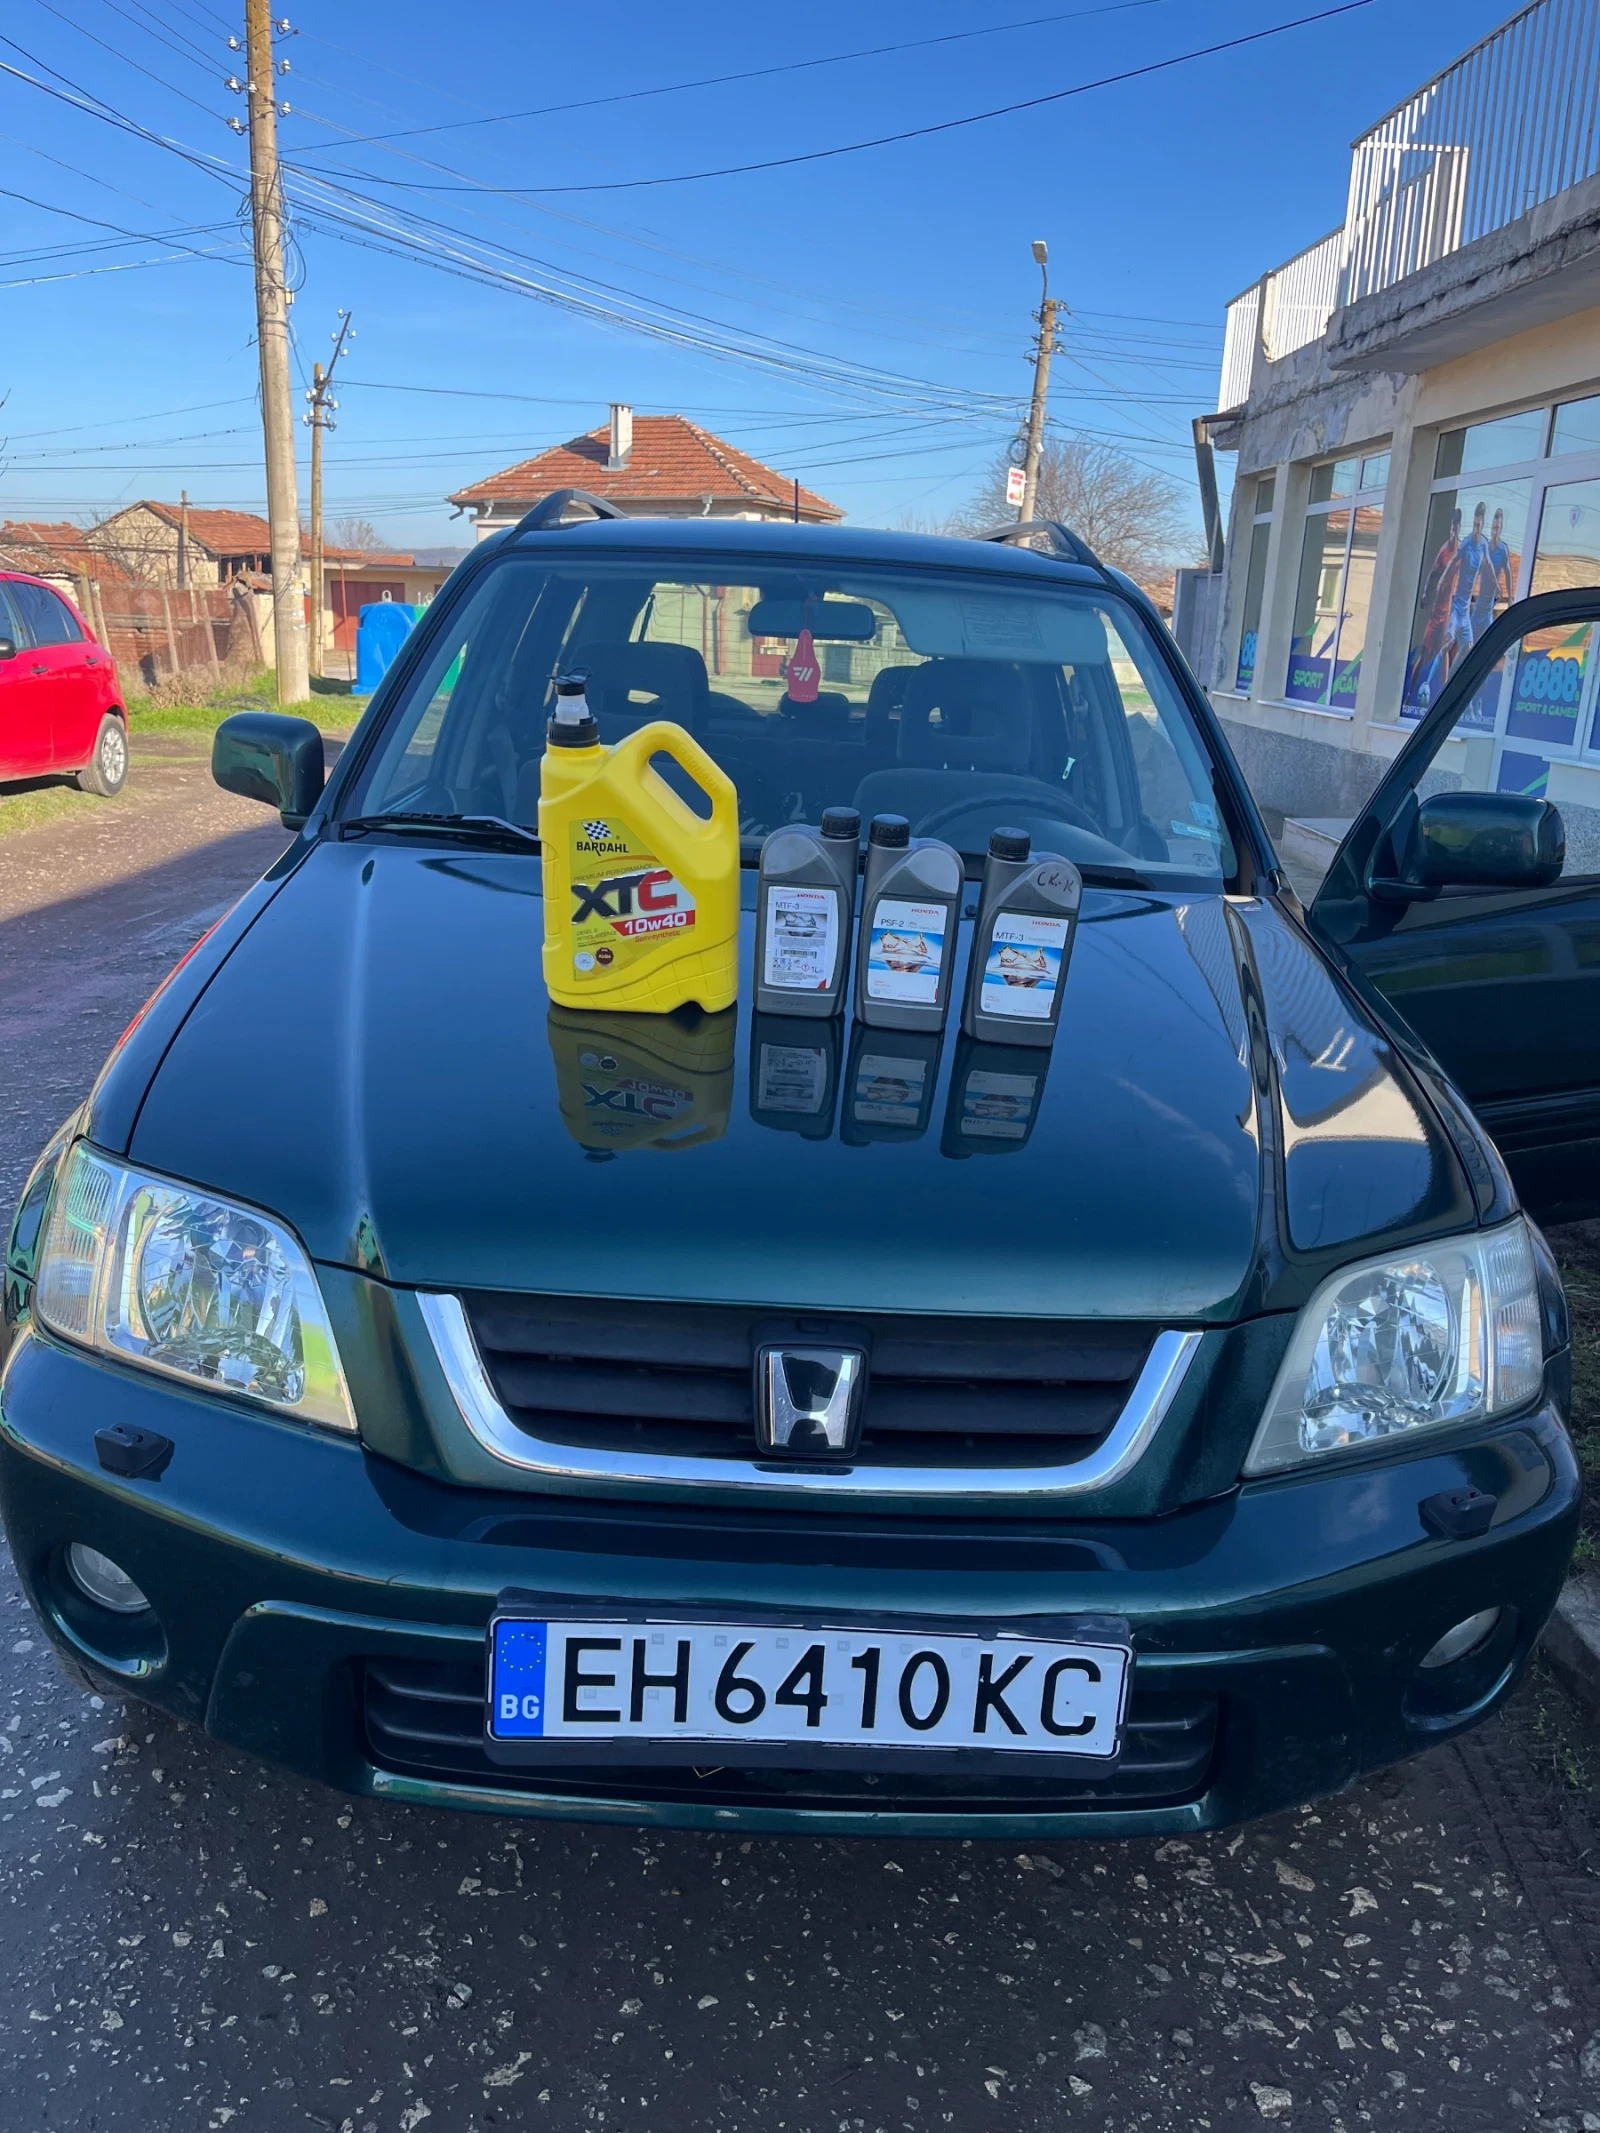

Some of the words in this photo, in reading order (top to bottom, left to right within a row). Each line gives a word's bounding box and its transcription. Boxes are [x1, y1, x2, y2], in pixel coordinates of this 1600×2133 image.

[1293, 669, 1324, 689] SPORT
[1515, 701, 1541, 714] SPORT
[1548, 705, 1579, 719] GAMES
[576, 841, 630, 857] BARDAHL
[573, 871, 605, 882] PREMIUM
[605, 863, 652, 877] PERFORMANCE
[570, 869, 678, 926] XTC
[775, 902, 800, 910] MTF-3
[624, 912, 687, 935] 10w40
[880, 918, 905, 928] PSF-2
[634, 930, 681, 943] Semi-synthetic
[995, 931, 1024, 941] MTF-3
[562, 1636, 691, 1723] EH
[713, 1640, 951, 1731] 6410
[972, 1652, 1102, 1737] KC
[500, 1694, 541, 1720] BG
